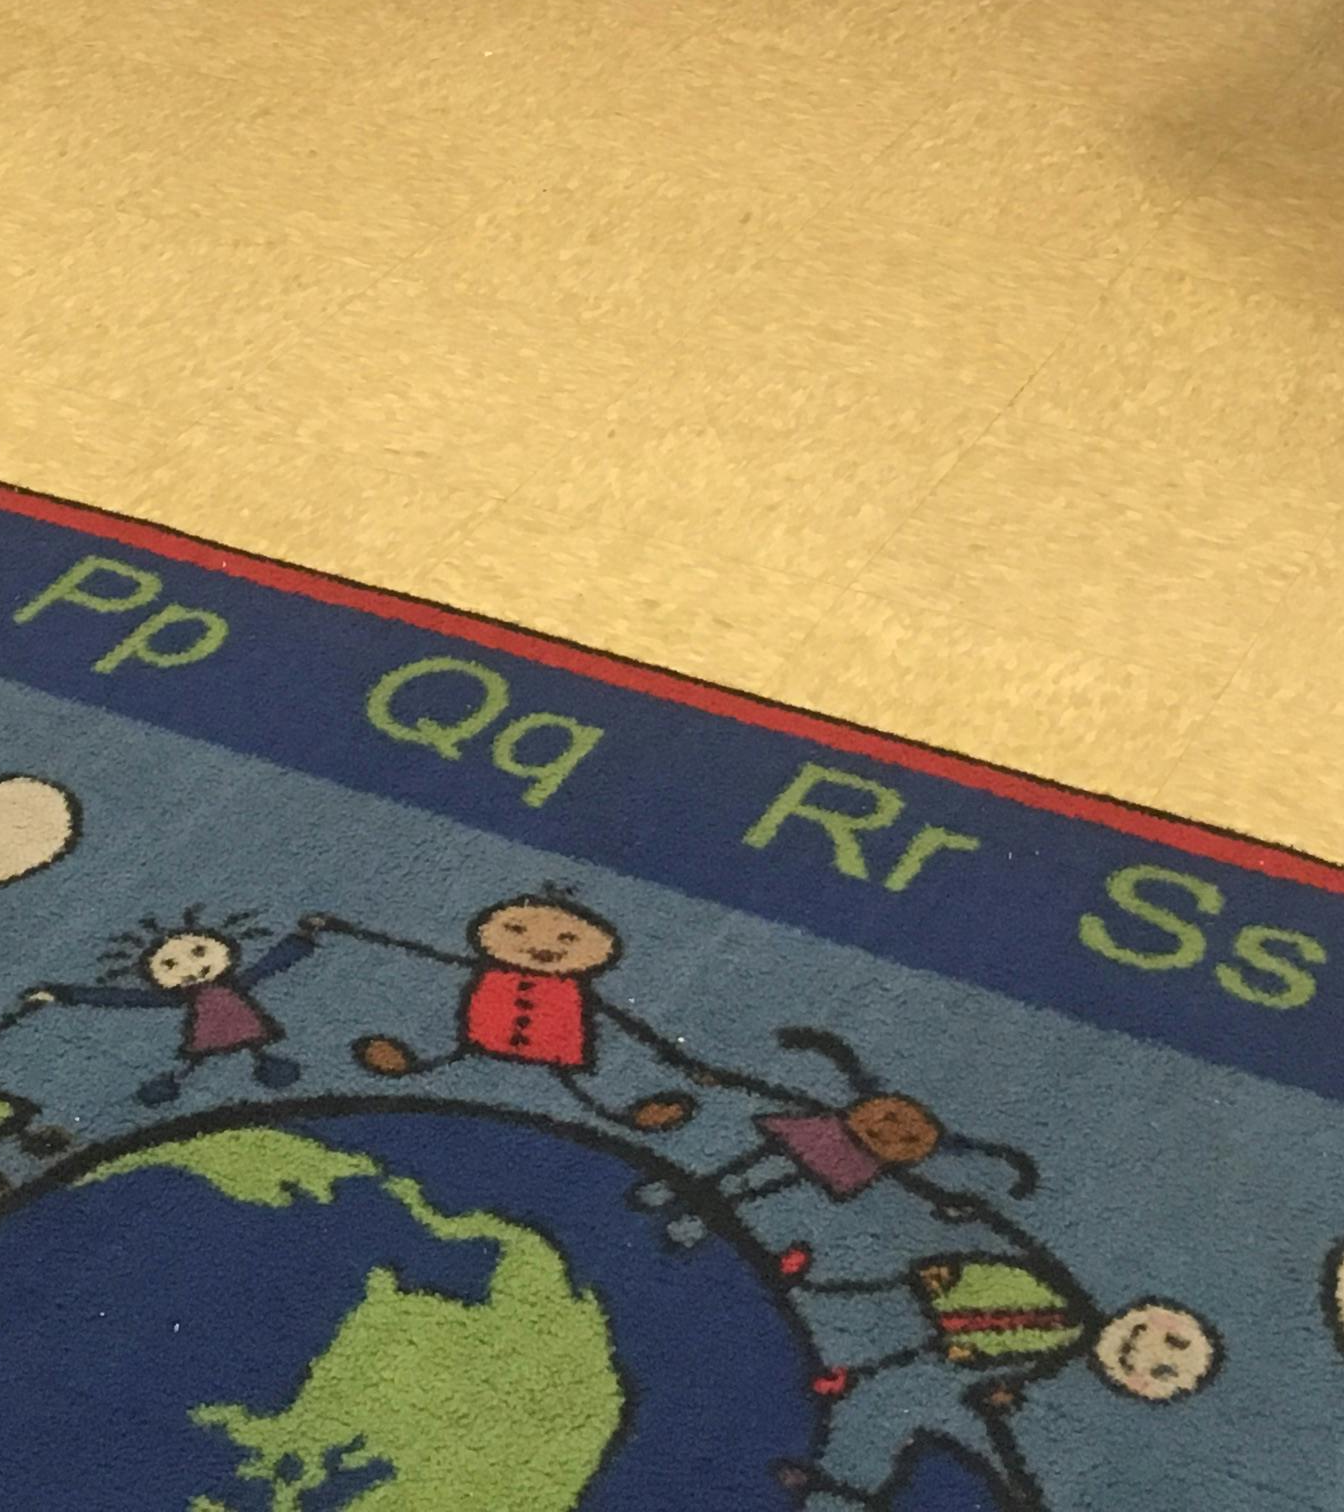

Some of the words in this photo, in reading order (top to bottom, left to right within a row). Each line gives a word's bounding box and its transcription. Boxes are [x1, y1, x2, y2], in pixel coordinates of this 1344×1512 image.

[13, 554, 230, 675] Pp
[364, 655, 605, 808] Qq
[740, 761, 981, 893] Rr
[1076, 863, 1329, 1011] Ss
